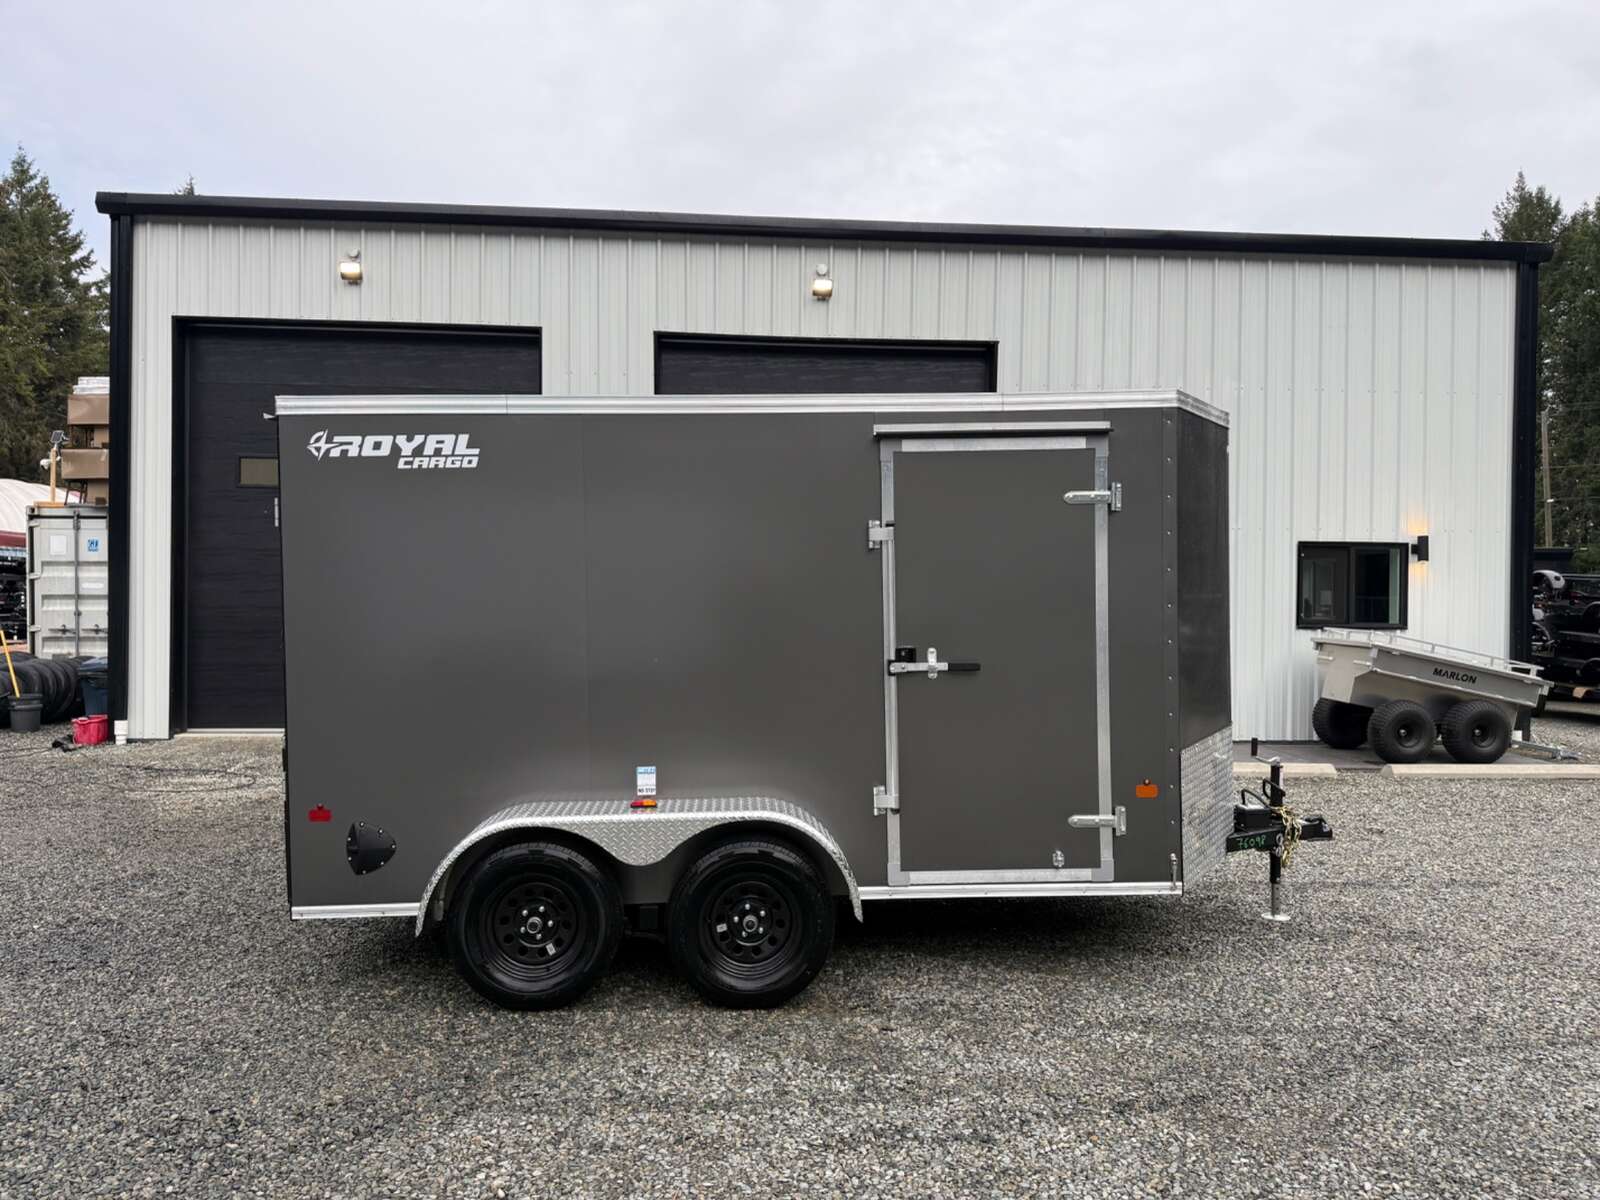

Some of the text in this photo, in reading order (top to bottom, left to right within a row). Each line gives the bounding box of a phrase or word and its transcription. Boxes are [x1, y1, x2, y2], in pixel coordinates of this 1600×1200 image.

[328, 433, 480, 457] ROYAL
[397, 456, 480, 469] CARGO
[1432, 667, 1478, 684] MARLON
